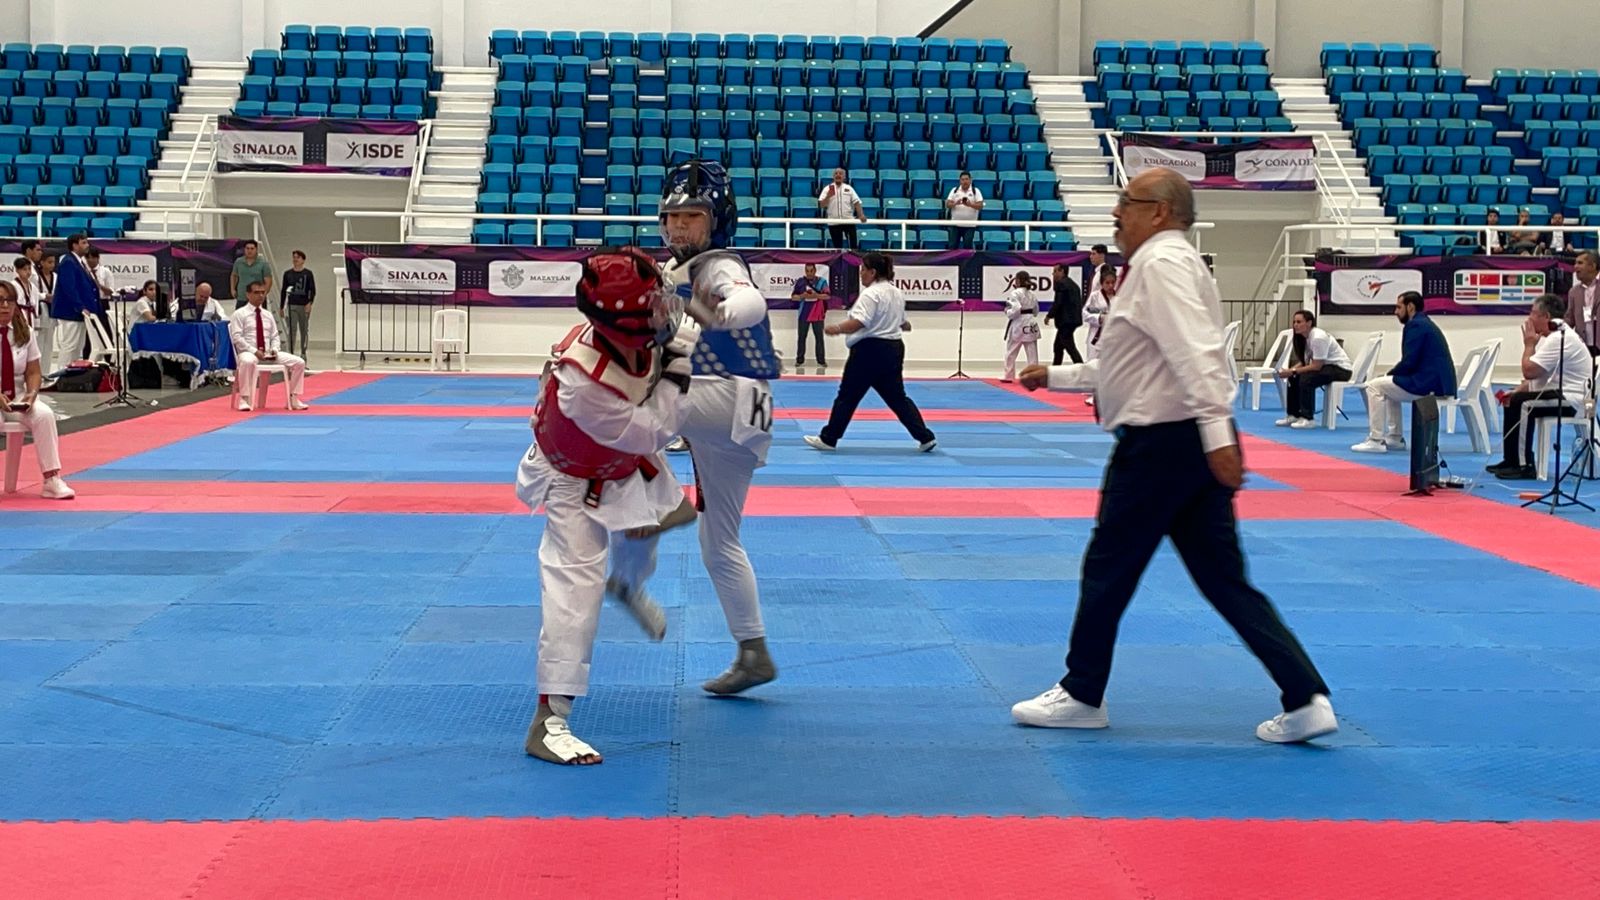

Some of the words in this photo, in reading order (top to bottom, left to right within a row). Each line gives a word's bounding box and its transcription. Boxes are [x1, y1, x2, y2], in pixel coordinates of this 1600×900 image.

[232, 143, 297, 156] SINALOA
[362, 143, 404, 158] ISDE
[1144, 157, 1197, 167] EDUCACIÓN
[387, 270, 448, 280] SINALOA
